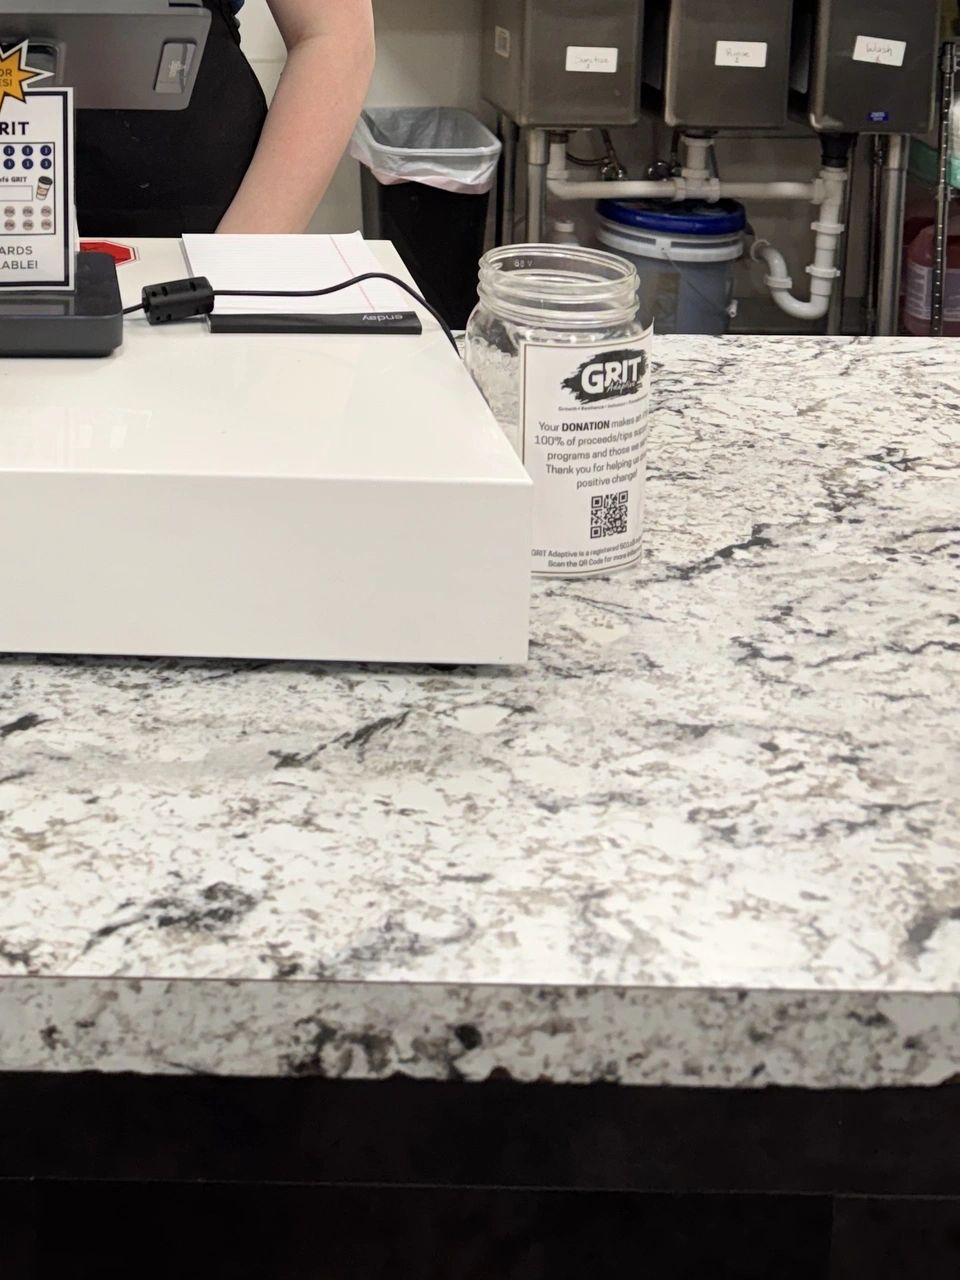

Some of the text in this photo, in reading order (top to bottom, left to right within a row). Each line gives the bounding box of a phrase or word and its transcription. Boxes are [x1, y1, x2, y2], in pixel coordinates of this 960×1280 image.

[581, 356, 642, 395] GRIT
[539, 421, 560, 431] Your
[562, 420, 610, 432] DONATION
[611, 417, 634, 428] makes
[534, 431, 632, 447] 100% of proceeds/tips
[547, 446, 630, 462] programs and those
[546, 458, 632, 477] Thank you for helping
[576, 476, 611, 489] positive
[548, 549, 578, 558] Adaptive
[590, 544, 620, 556] registered
[548, 560, 565, 568] Scan
[566, 559, 578, 568] the
[578, 559, 588, 567] QR
[588, 557, 604, 566] Code
[604, 555, 613, 563] for
